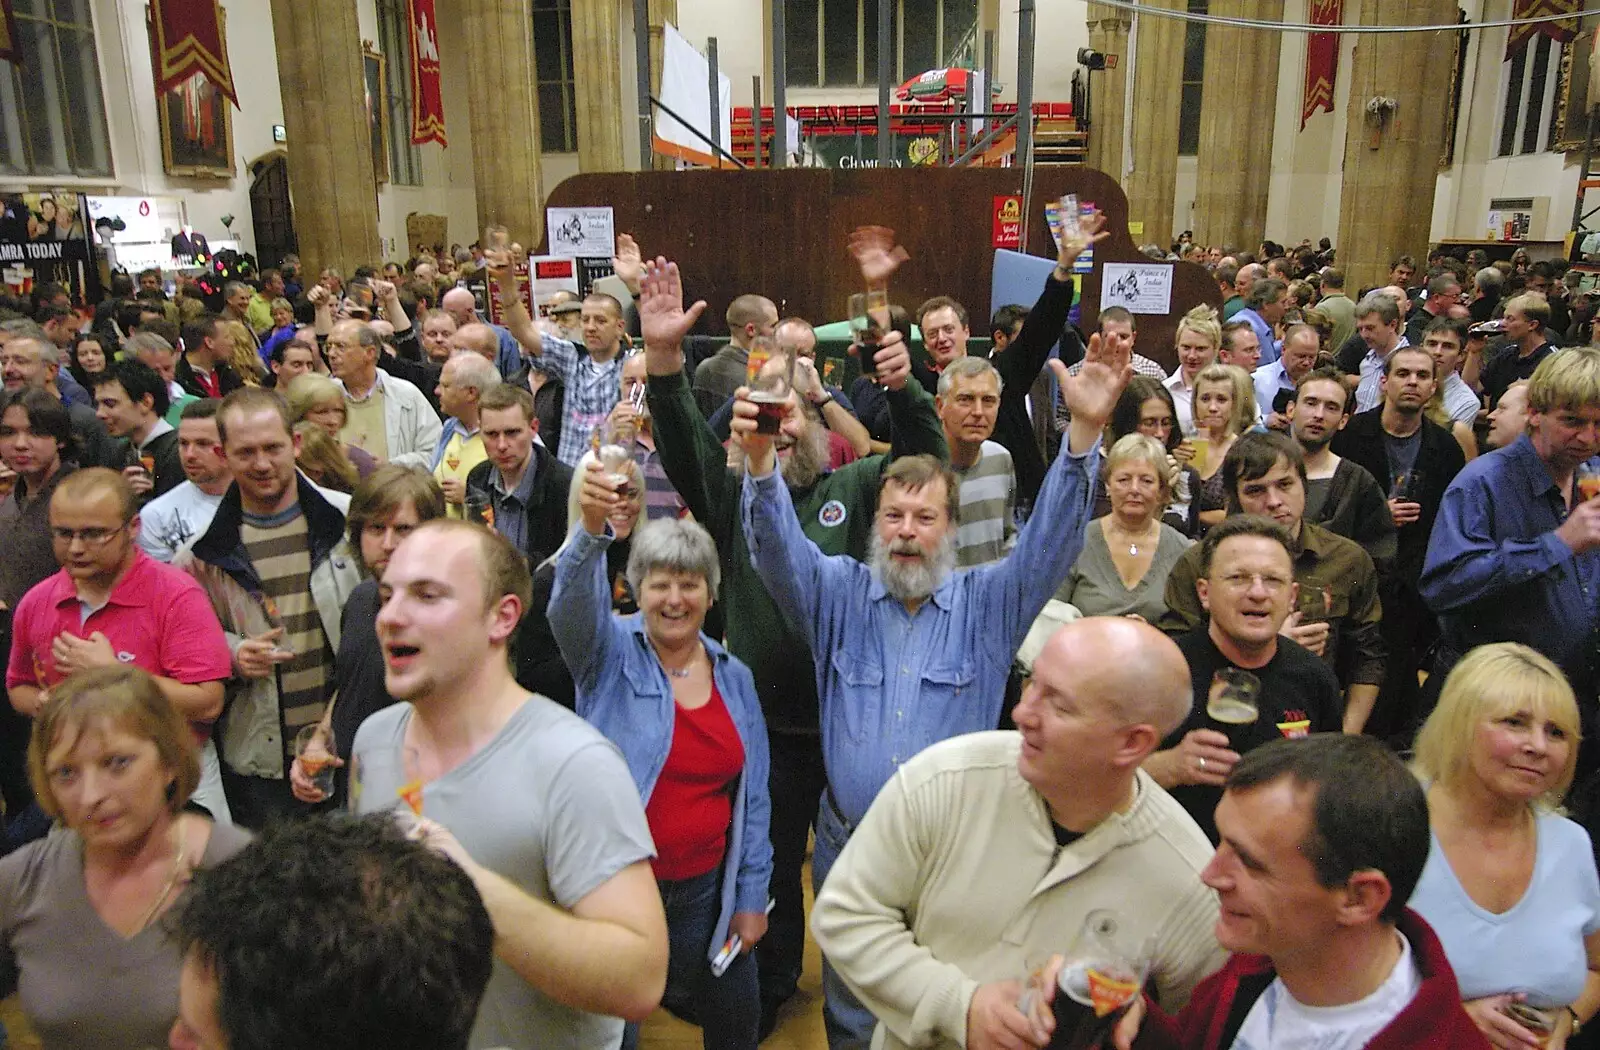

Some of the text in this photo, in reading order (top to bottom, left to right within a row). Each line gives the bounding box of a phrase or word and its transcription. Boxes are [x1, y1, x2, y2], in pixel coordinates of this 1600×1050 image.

[26, 242, 62, 259] TODAY
[1139, 269, 1168, 279] Prince of
[1143, 277, 1162, 286] India
